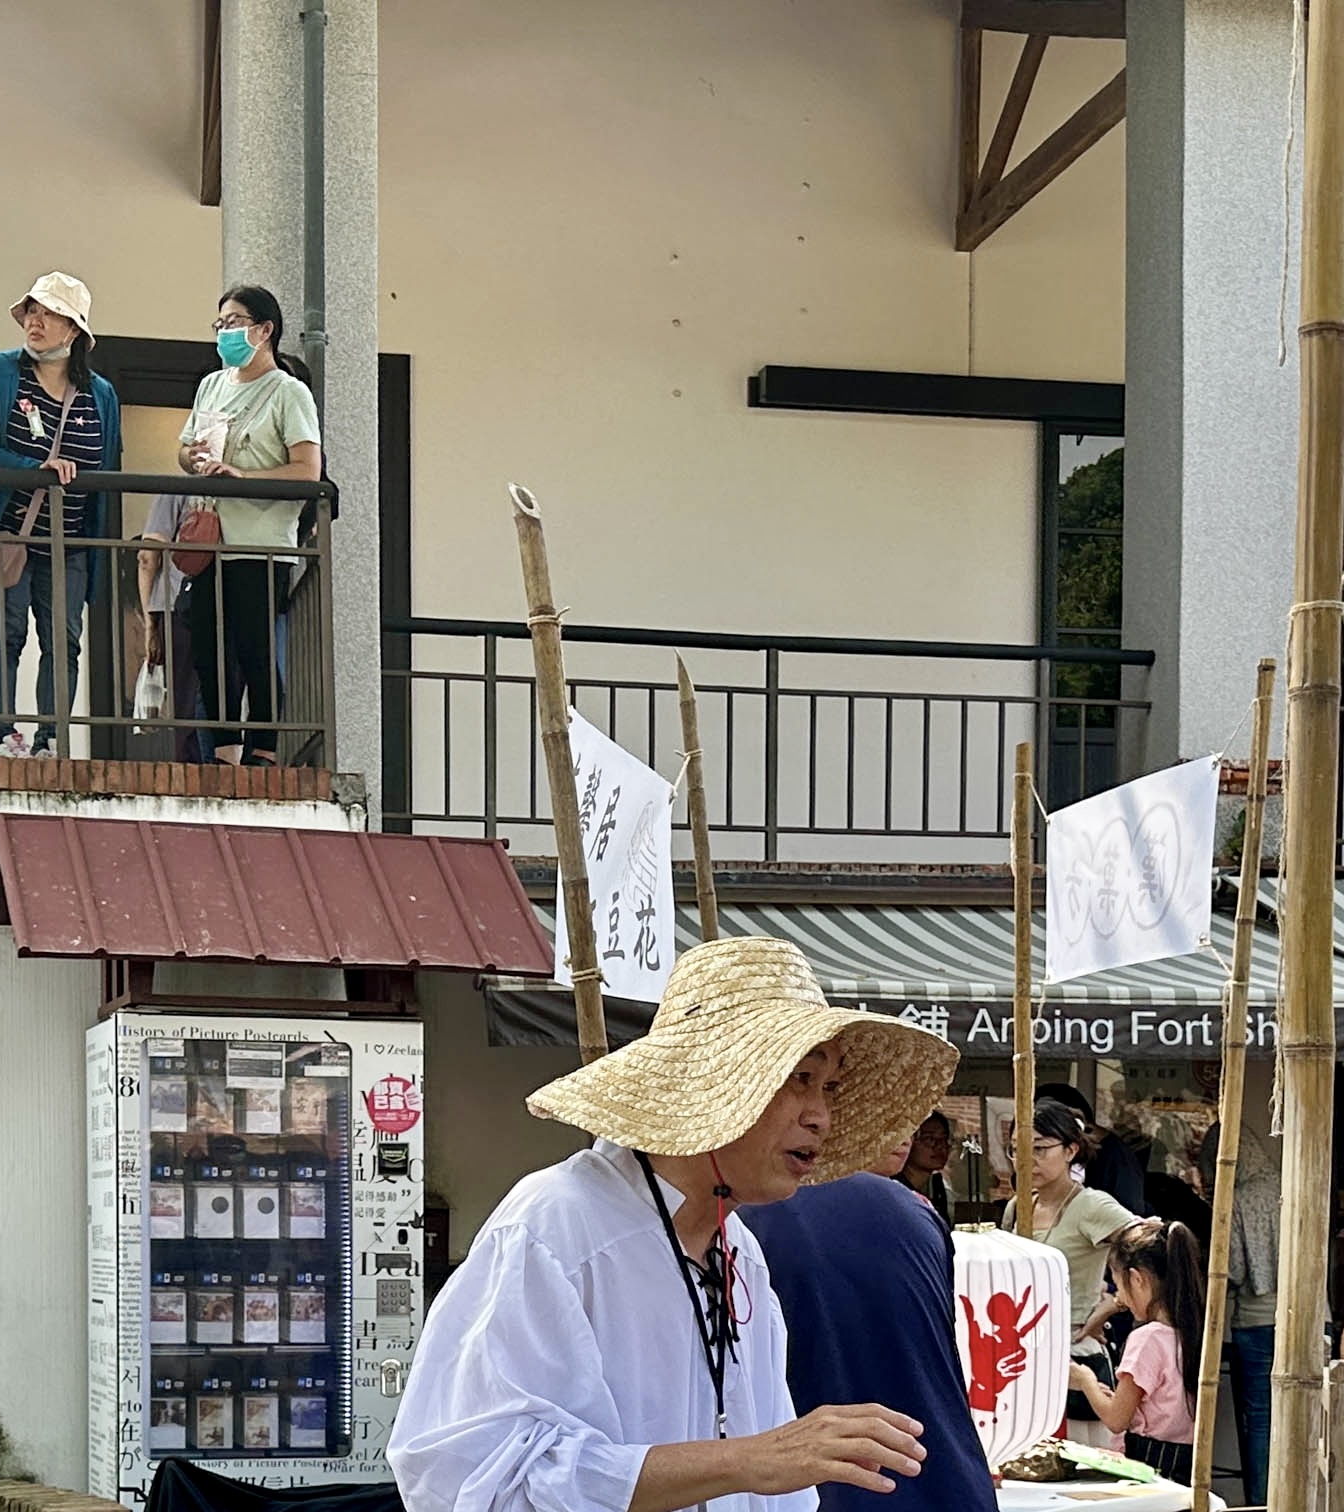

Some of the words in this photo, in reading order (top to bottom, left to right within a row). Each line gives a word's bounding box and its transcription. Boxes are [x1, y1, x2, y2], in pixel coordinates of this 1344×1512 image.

[172, 1026, 185, 1037] of
[190, 1026, 240, 1040] Picture
[244, 1028, 309, 1042] Postcards
[1131, 1010, 1212, 1045] Fort
